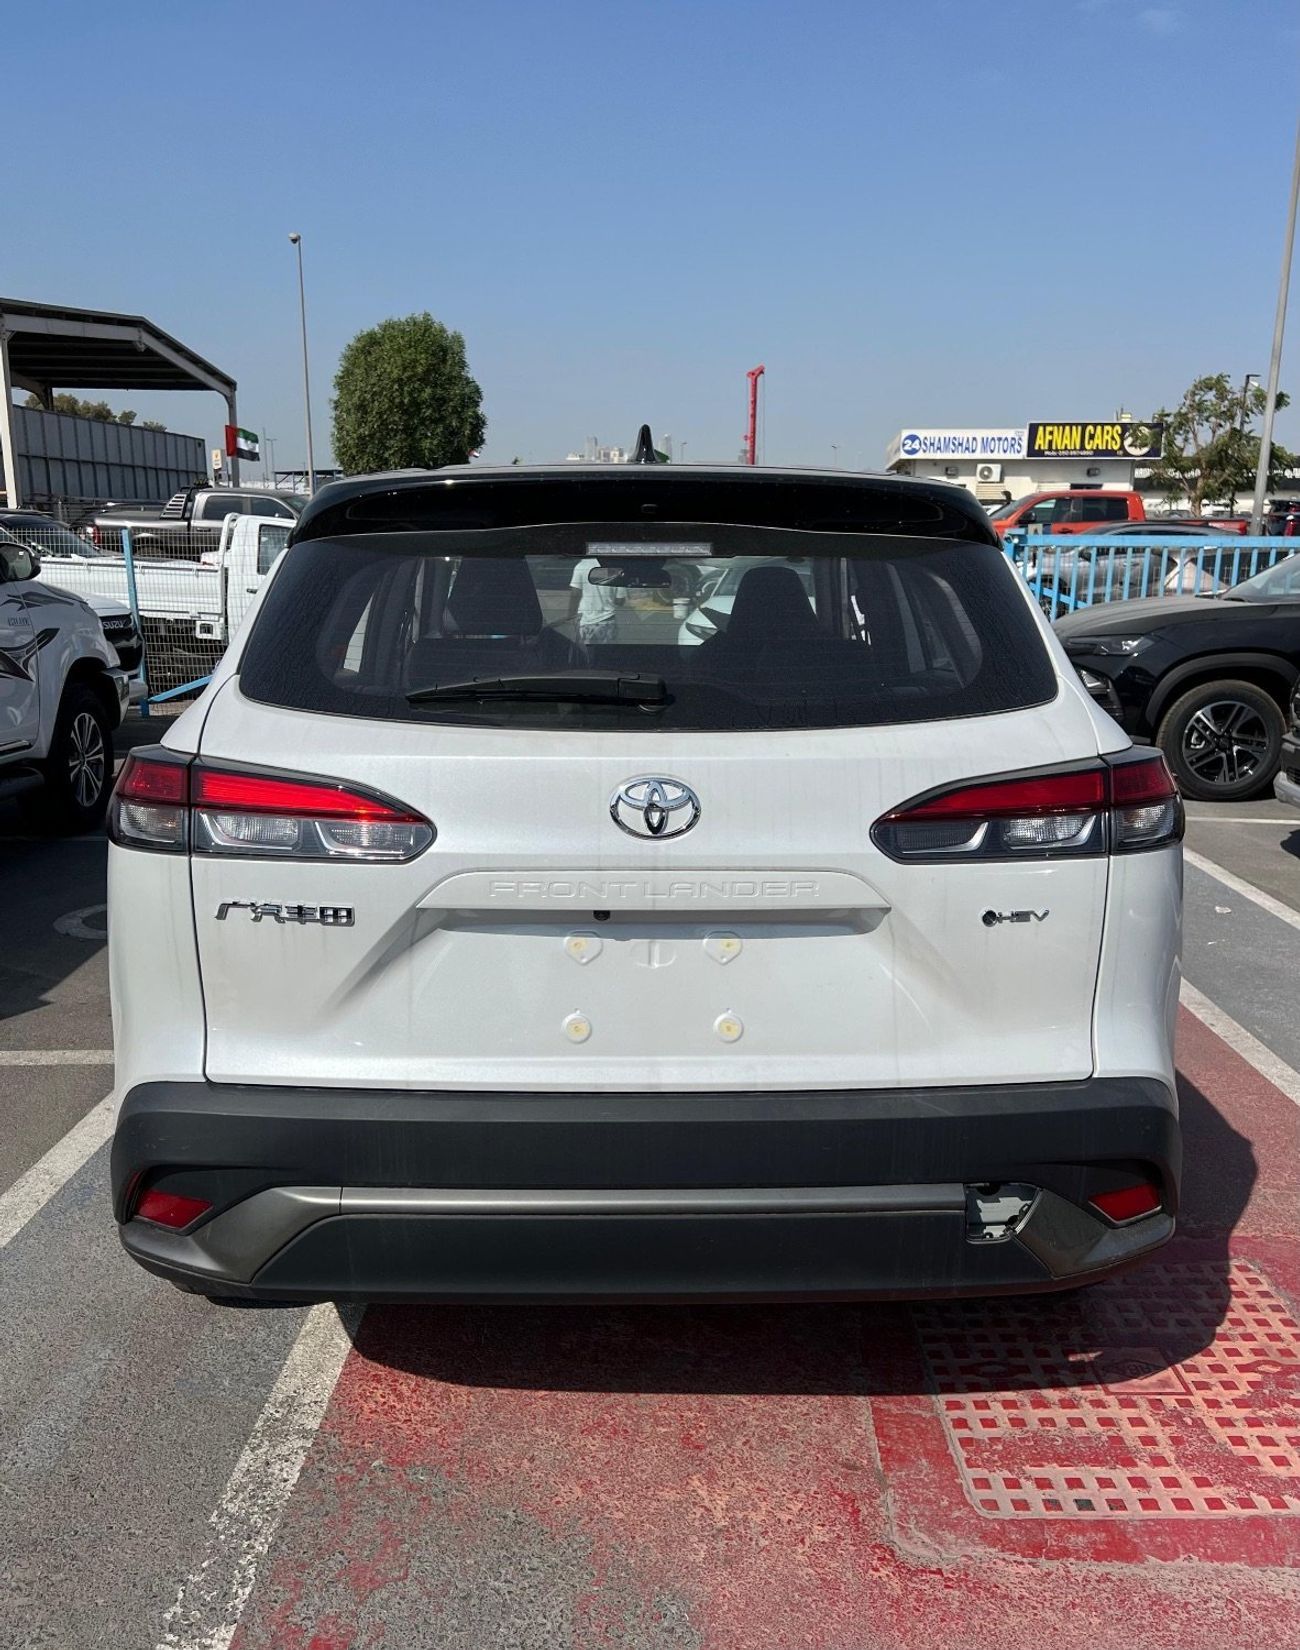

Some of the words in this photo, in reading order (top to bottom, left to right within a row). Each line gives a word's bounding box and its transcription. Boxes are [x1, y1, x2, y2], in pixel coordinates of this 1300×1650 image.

[922, 436, 978, 454] SHAMSHAD
[980, 436, 1023, 454] MOTORS
[1034, 425, 1082, 450] AFNAN
[1084, 424, 1122, 451] CARS
